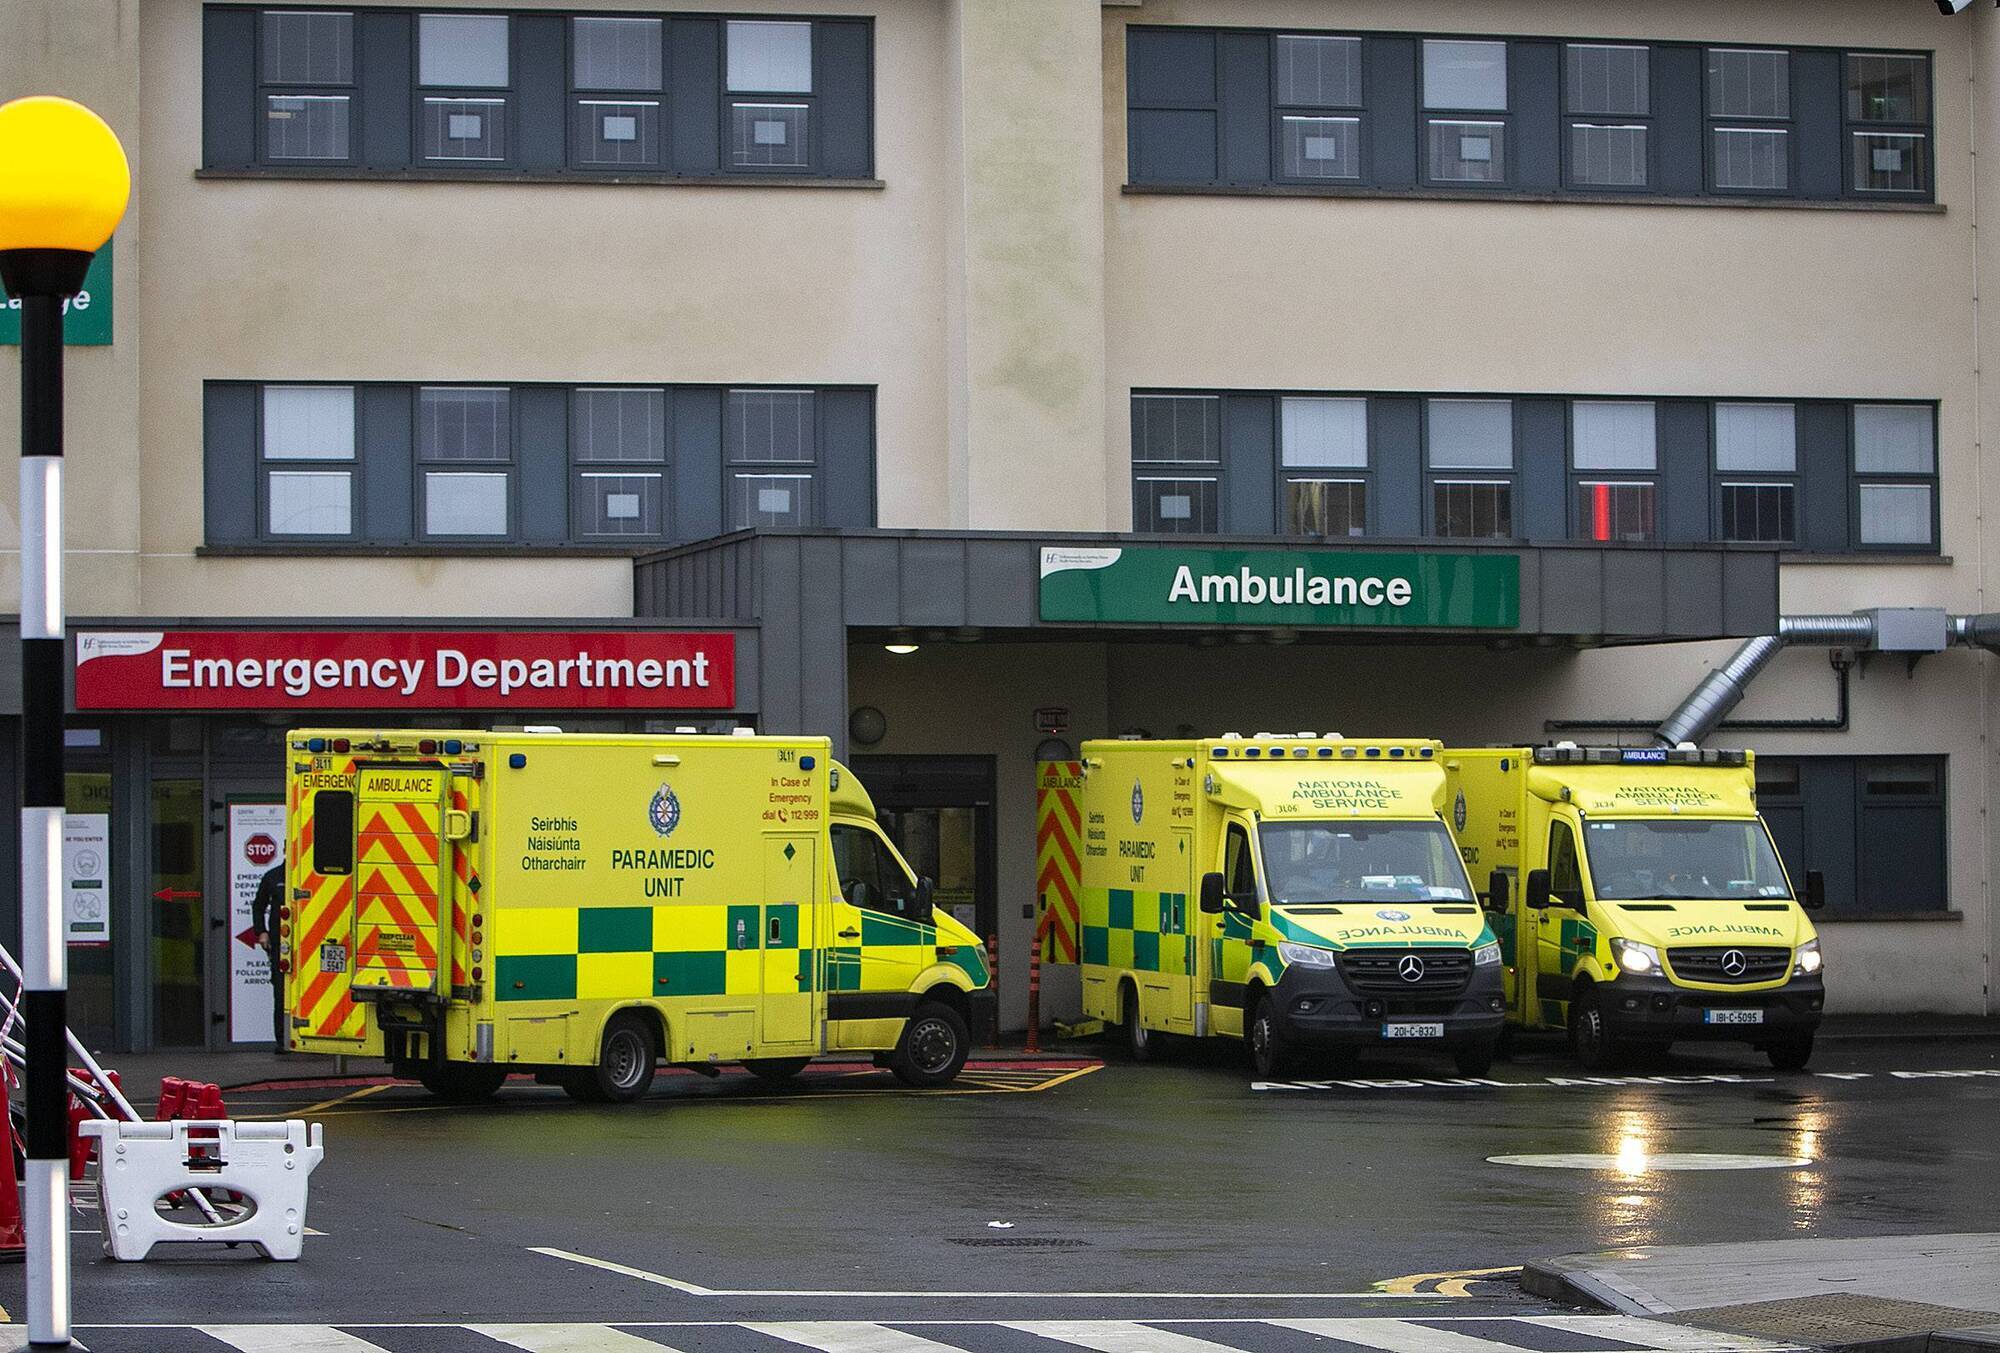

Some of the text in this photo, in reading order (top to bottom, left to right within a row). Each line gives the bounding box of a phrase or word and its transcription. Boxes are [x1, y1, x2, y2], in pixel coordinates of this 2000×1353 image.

[1168, 565, 1412, 605] Ambulance
[161, 649, 709, 696] Emergency Department
[779, 750, 794, 761] 3L11
[1622, 751, 1666, 760] AMBULANCE
[315, 758, 331, 769] 3L11
[303, 775, 356, 788] EMERGENC
[367, 778, 433, 792] AMBULANCE
[771, 776, 811, 787] In Case of
[1043, 777, 1081, 788] AMBULANCE
[1297, 780, 1387, 789] NATIONAL
[769, 792, 812, 805] Emergency
[1292, 789, 1404, 799] AMBULANCE
[1615, 792, 1722, 801] AMBULANCE
[1312, 798, 1389, 809] SERVICE
[762, 810, 776, 820] dial
[531, 816, 578, 831] Seirbhís
[527, 835, 581, 851] Náisiúnta
[247, 844, 276, 856] STOP
[1119, 840, 1156, 860] PARAMEDIC
[521, 856, 587, 870] Otharchairr
[612, 849, 715, 869] PARAMEDIC
[1129, 865, 1145, 883] UNIT
[644, 878, 684, 897] UNIT
[235, 968, 270, 977] FOLLOW
[1716, 1012, 1757, 1022] 181-C-5095
[1394, 1026, 1437, 1036] 201-C-8321
[1251, 1075, 1775, 1090] AMBULANCE
